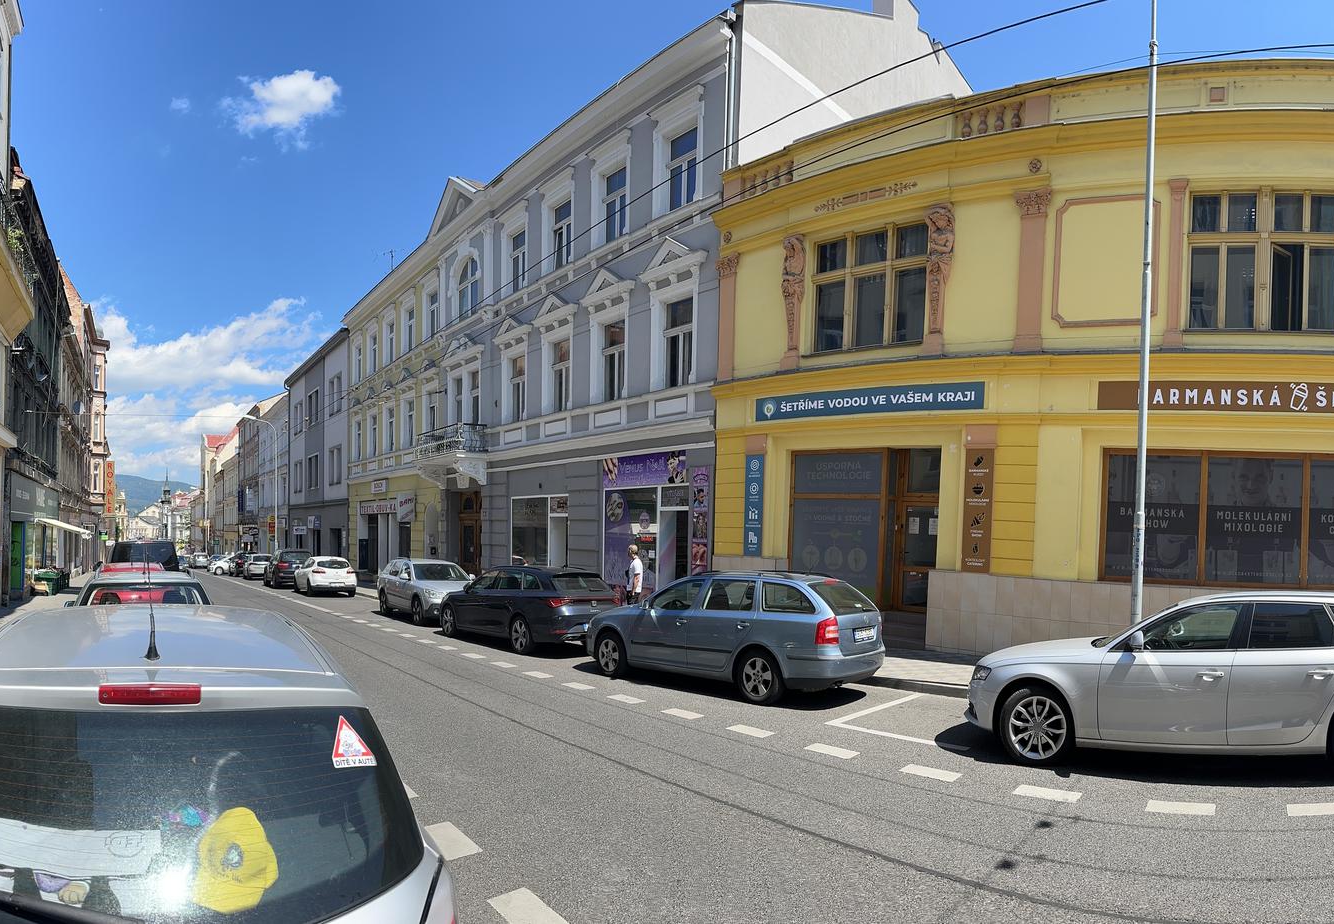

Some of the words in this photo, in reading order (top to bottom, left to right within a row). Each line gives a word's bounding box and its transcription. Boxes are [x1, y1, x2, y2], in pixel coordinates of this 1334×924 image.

[780, 399, 824, 413] ŠETŘÍME
[827, 397, 868, 409] VODOU
[871, 395, 887, 406] VE
[890, 390, 933, 405] VAŠEM
[937, 390, 975, 403] KRAJI
[1137, 386, 1281, 406] ARMANSKÁ
[1145, 519, 1169, 528] HOW
[1224, 522, 1284, 533] MIXOLOGIE
